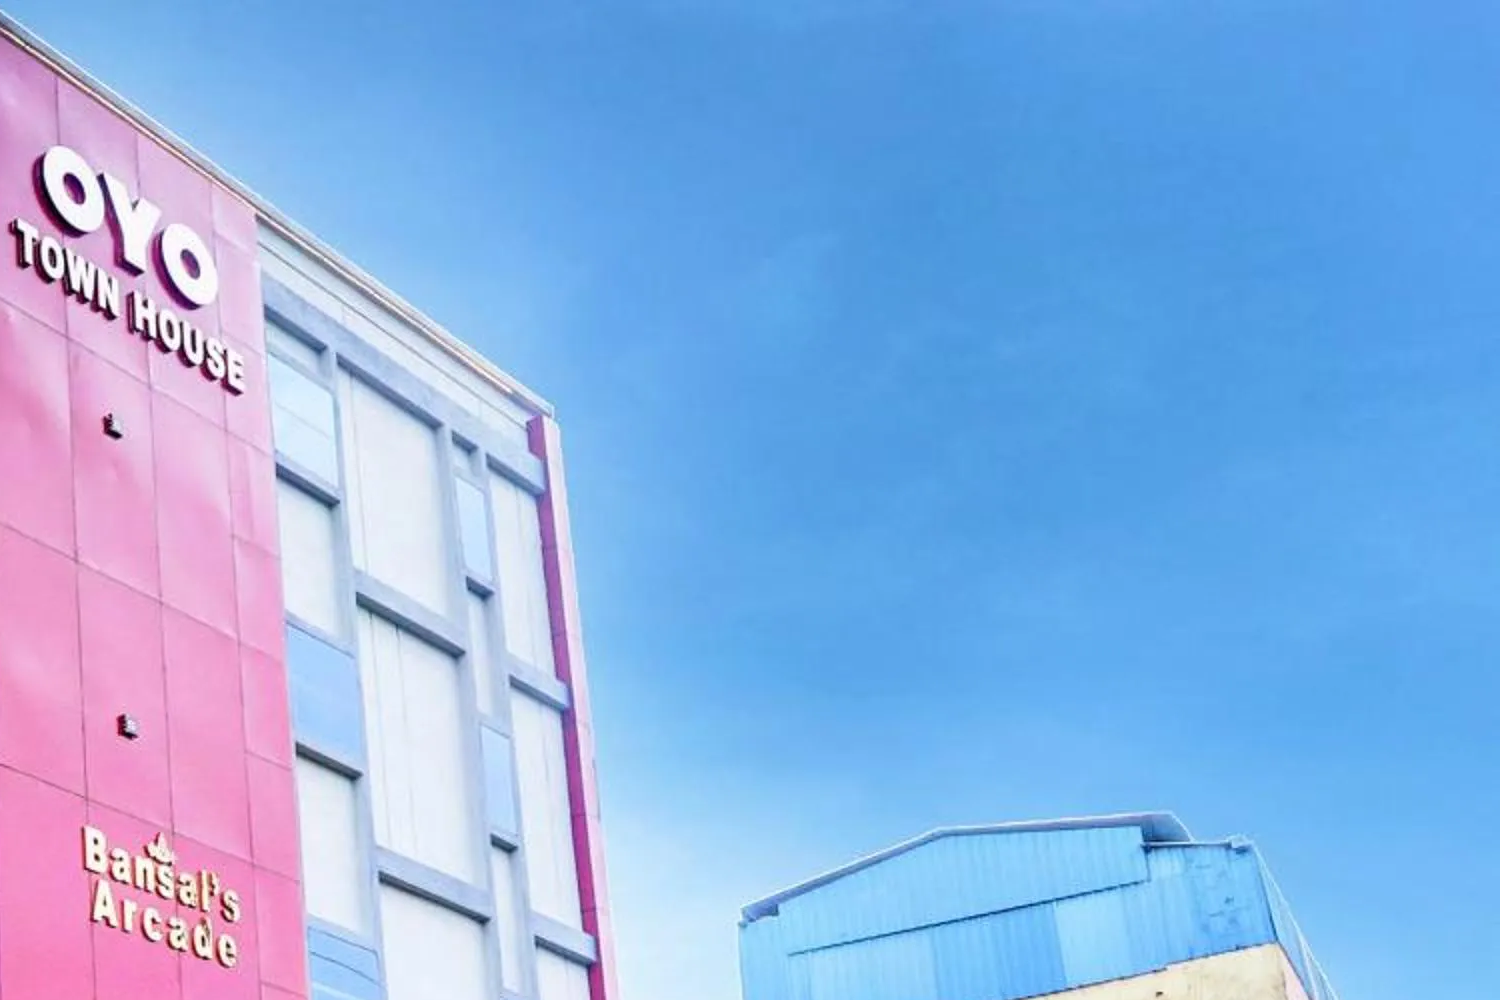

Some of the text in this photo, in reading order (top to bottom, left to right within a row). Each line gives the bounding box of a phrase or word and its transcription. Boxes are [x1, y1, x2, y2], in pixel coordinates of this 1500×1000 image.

[32, 145, 218, 310] OYO
[8, 218, 246, 396] TOWN HOUSE
[81, 825, 241, 923] Bansal's
[90, 878, 238, 969] Arcade
